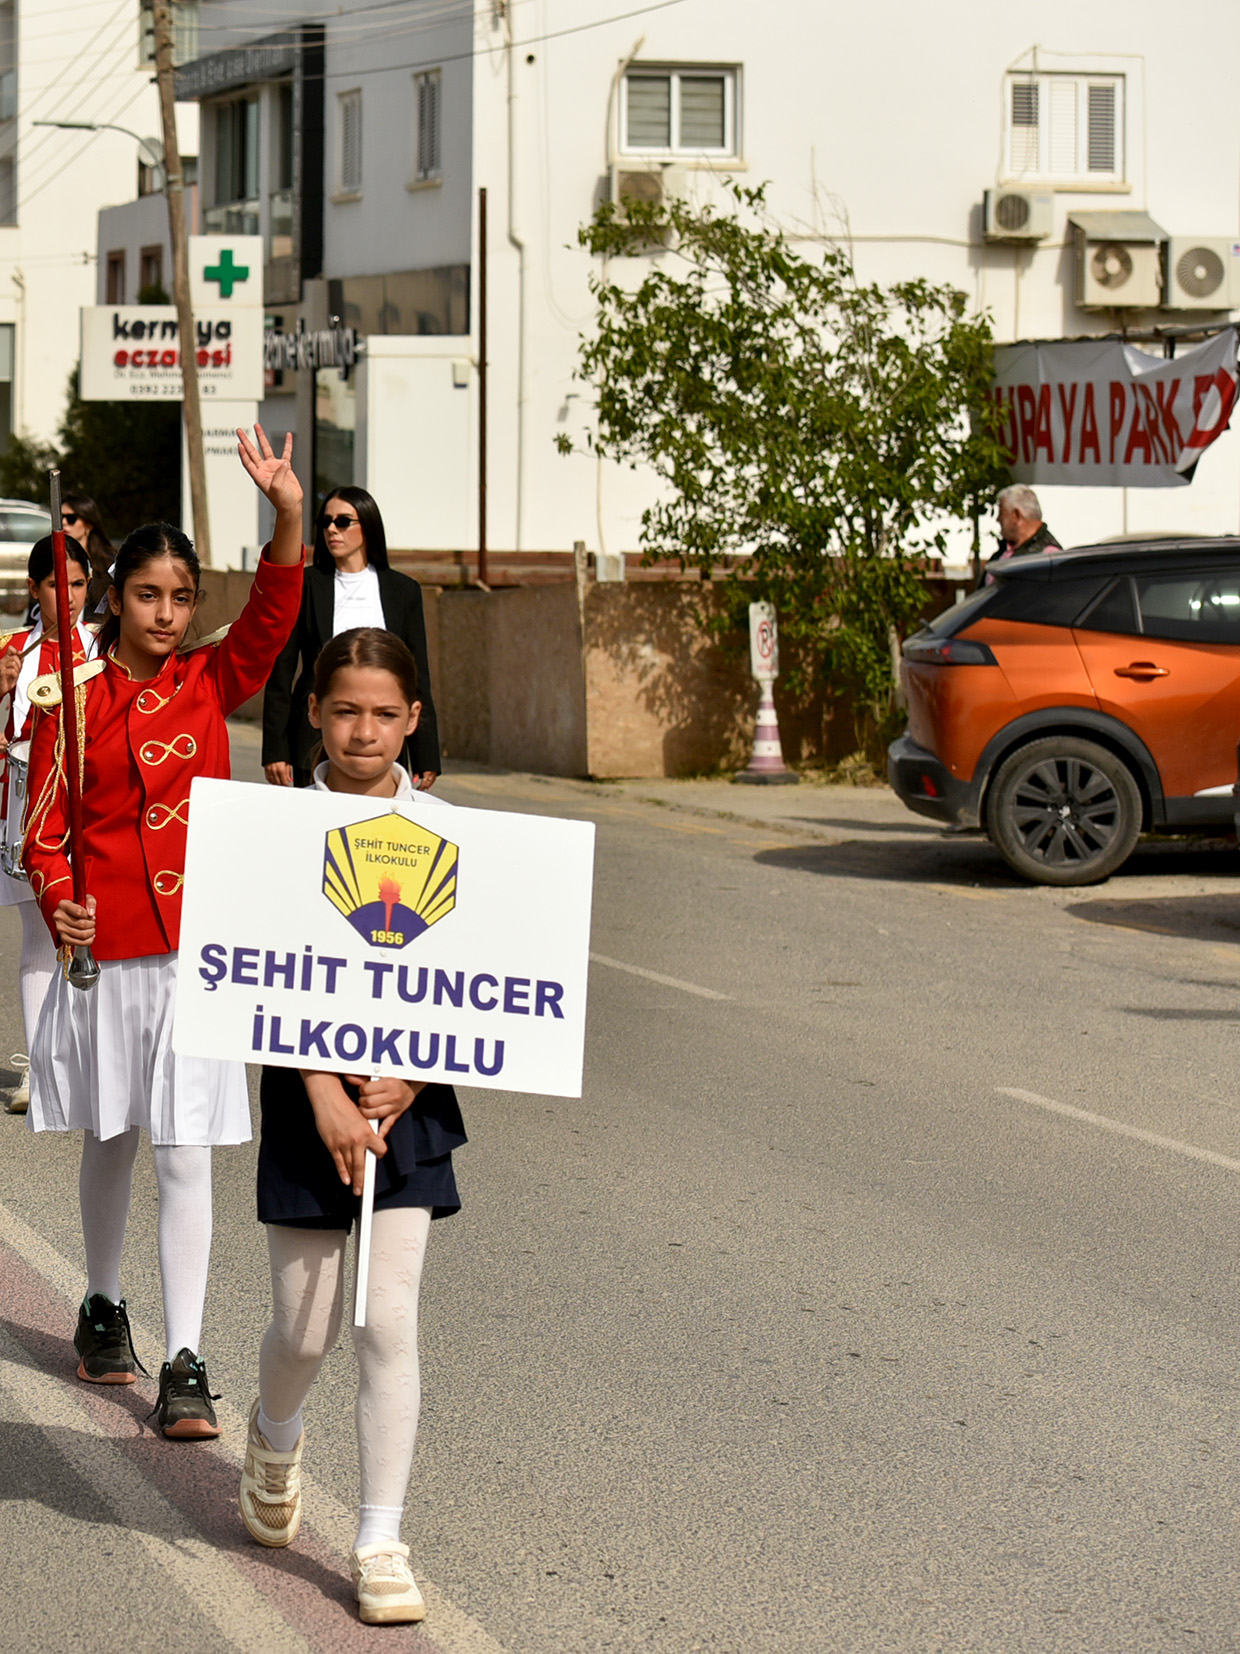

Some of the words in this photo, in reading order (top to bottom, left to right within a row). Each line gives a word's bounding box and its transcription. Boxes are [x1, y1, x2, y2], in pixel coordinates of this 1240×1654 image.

[113, 312, 232, 347] kermya
[114, 342, 232, 368] eczaesi
[354, 838, 384, 850] ŞEHİT
[386, 842, 430, 855] TUNCER
[365, 851, 418, 867] İLKOKULU
[370, 930, 404, 945] 1956
[198, 943, 347, 994] ŞEHİT
[363, 961, 565, 1020] TUNCER
[251, 1004, 506, 1077] İLKOKULU
